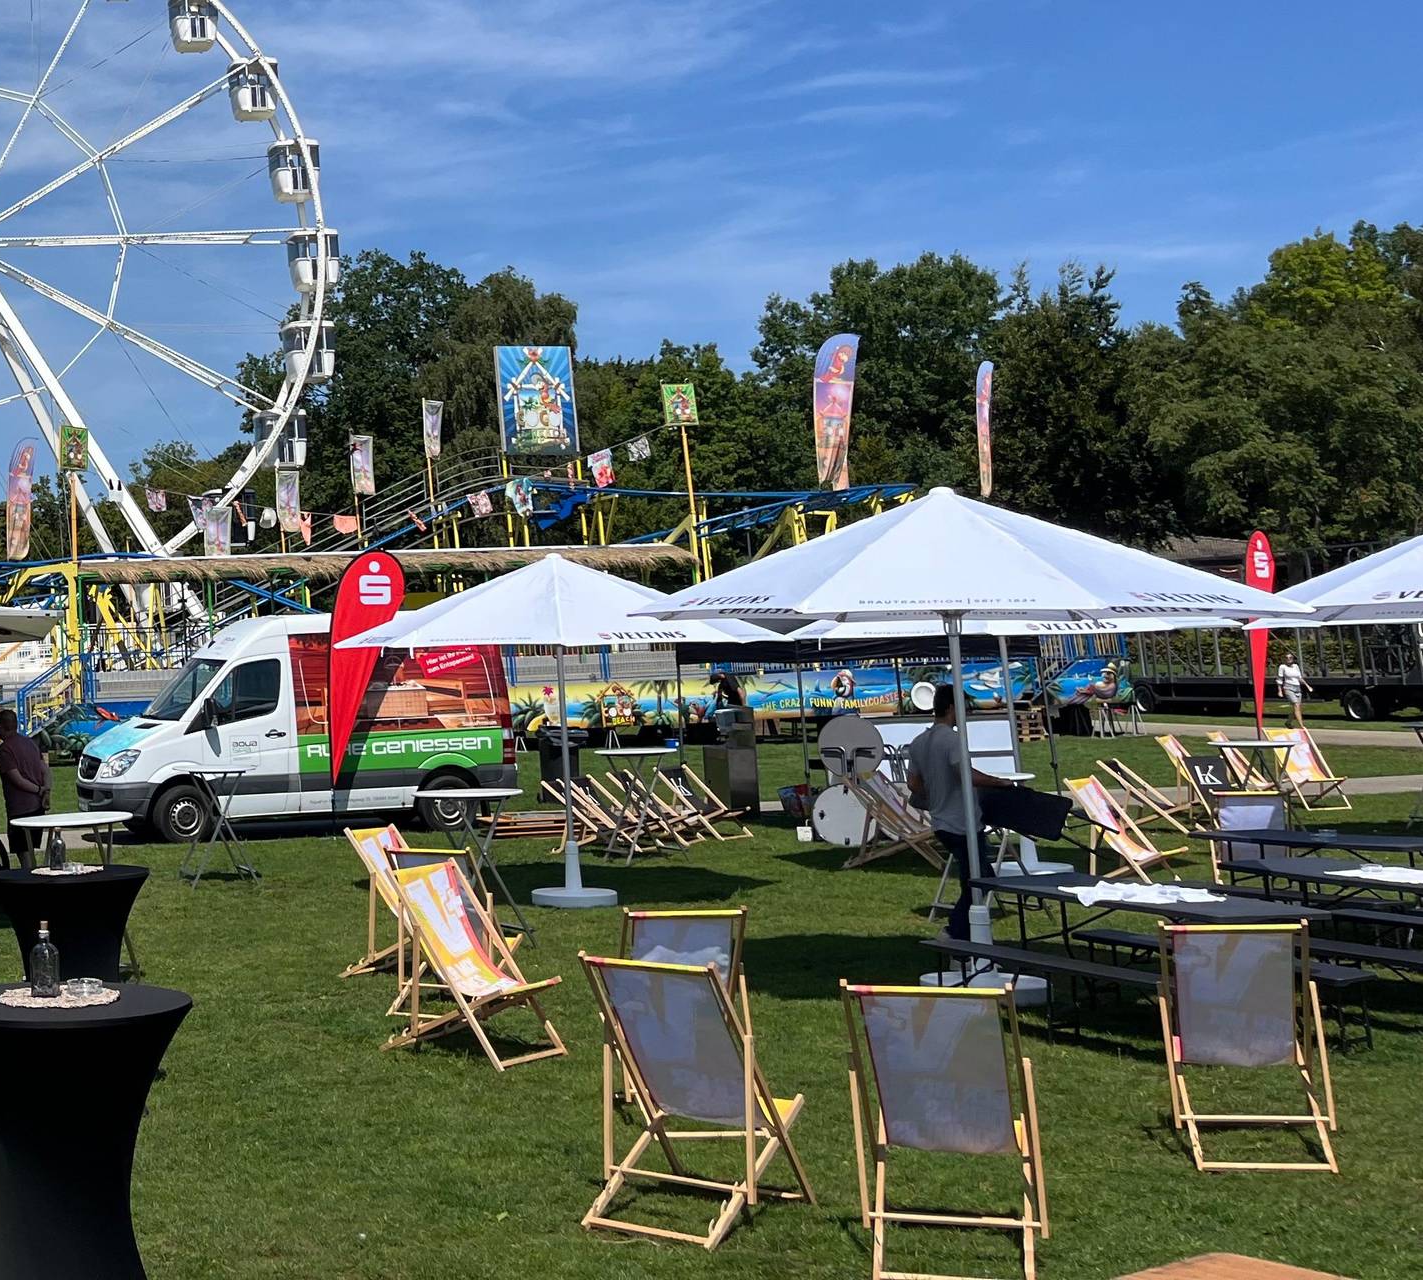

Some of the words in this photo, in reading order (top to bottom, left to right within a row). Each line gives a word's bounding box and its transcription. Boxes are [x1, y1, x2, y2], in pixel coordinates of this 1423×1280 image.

[1040, 623, 1117, 631] VELTINS
[612, 631, 687, 639] VELTINS
[809, 697, 837, 709] FUNNY
